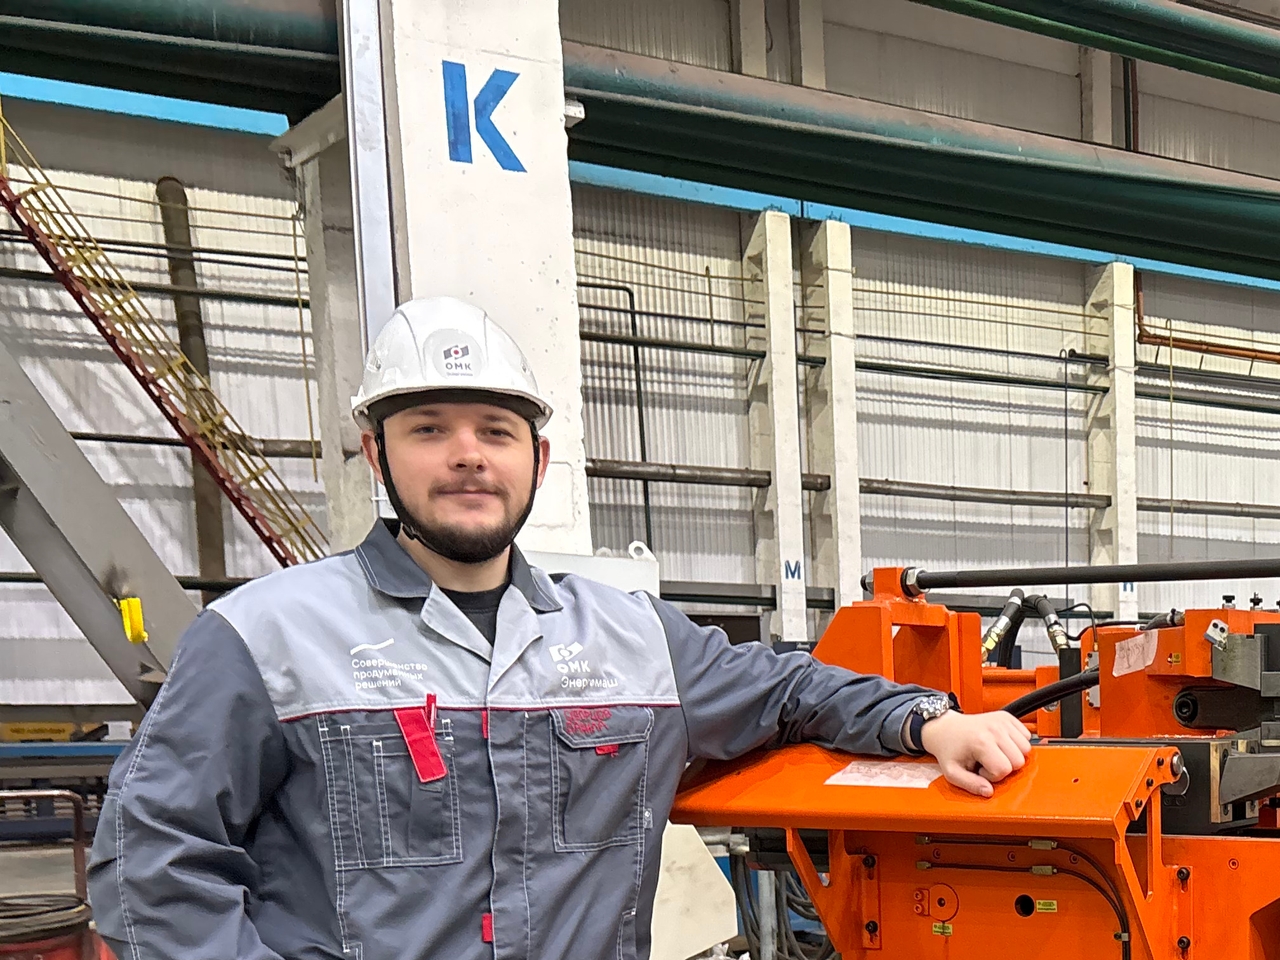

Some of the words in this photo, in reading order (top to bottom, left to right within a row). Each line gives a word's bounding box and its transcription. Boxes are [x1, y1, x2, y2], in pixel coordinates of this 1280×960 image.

[442, 59, 528, 172] К
[445, 362, 472, 371] ОМК
[785, 560, 801, 580] М
[556, 660, 591, 674] ОМК
[355, 679, 402, 692] решений
